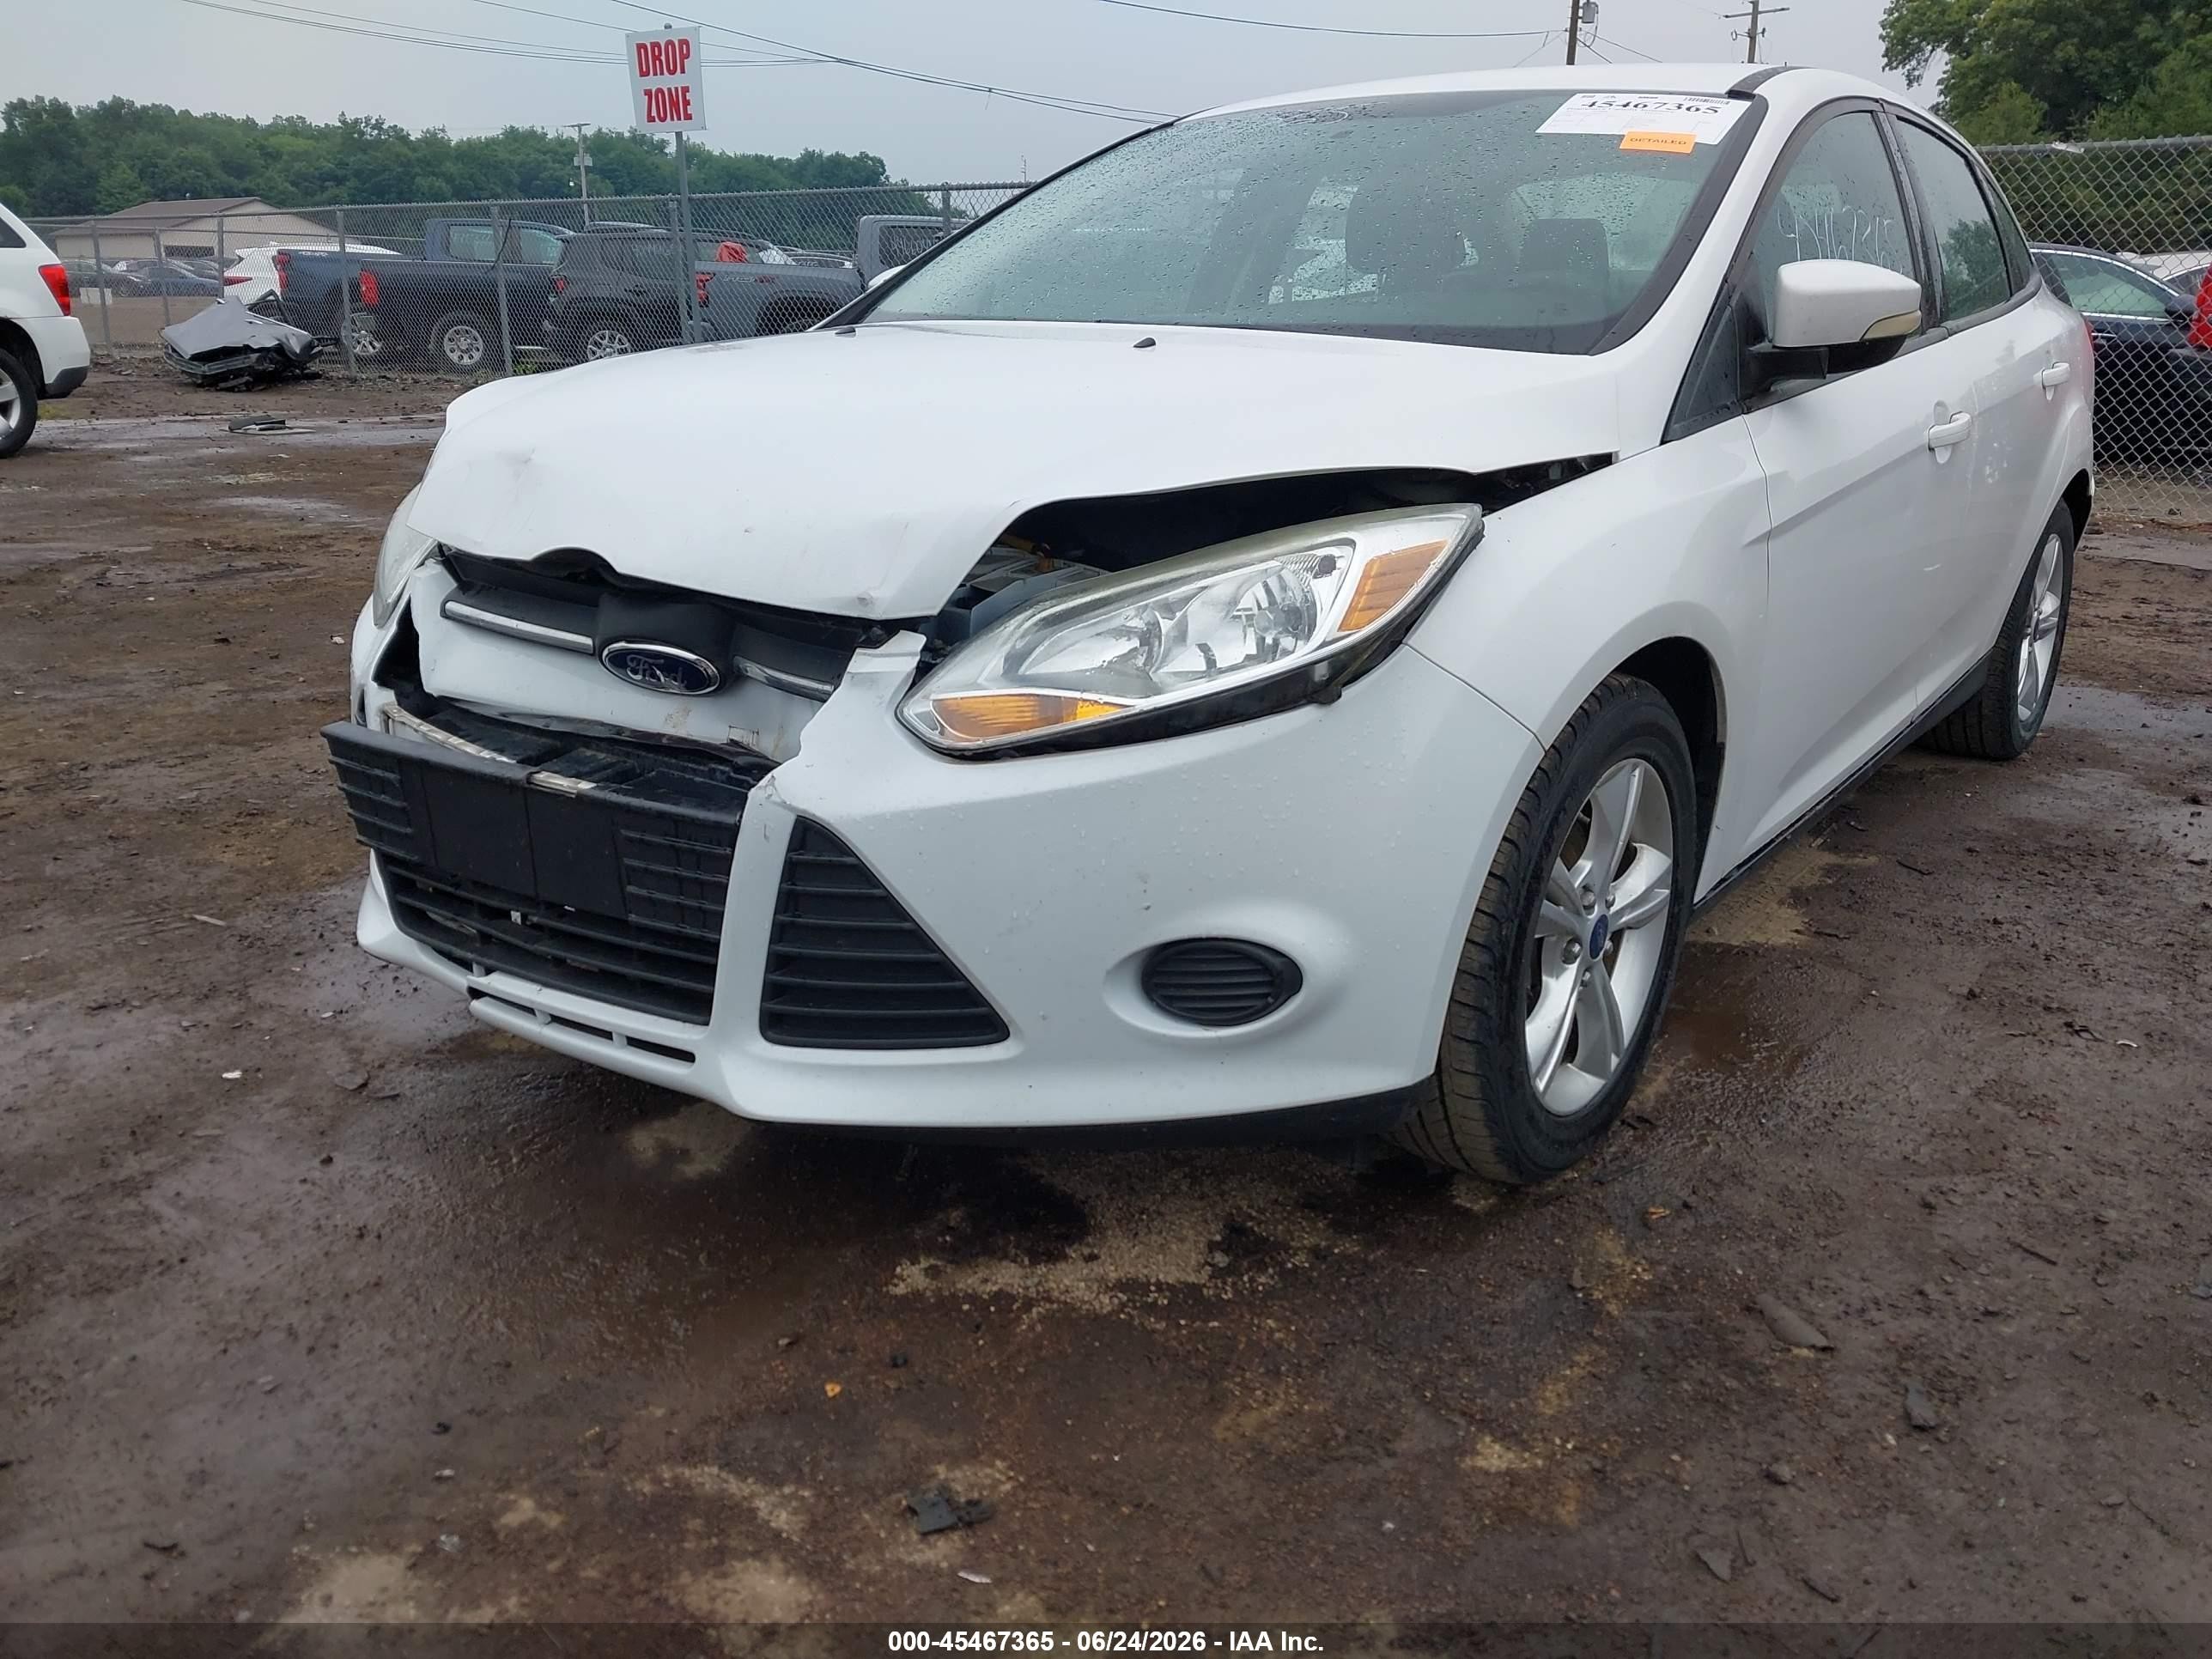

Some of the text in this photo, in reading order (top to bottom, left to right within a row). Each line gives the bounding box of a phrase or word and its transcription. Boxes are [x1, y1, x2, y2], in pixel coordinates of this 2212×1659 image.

[635, 39, 690, 77] DROP
[643, 86, 693, 123] ZONE
[1581, 100, 1722, 114] 45467365
[1629, 137, 1687, 146] DETAILED
[626, 654, 687, 688] Ford
